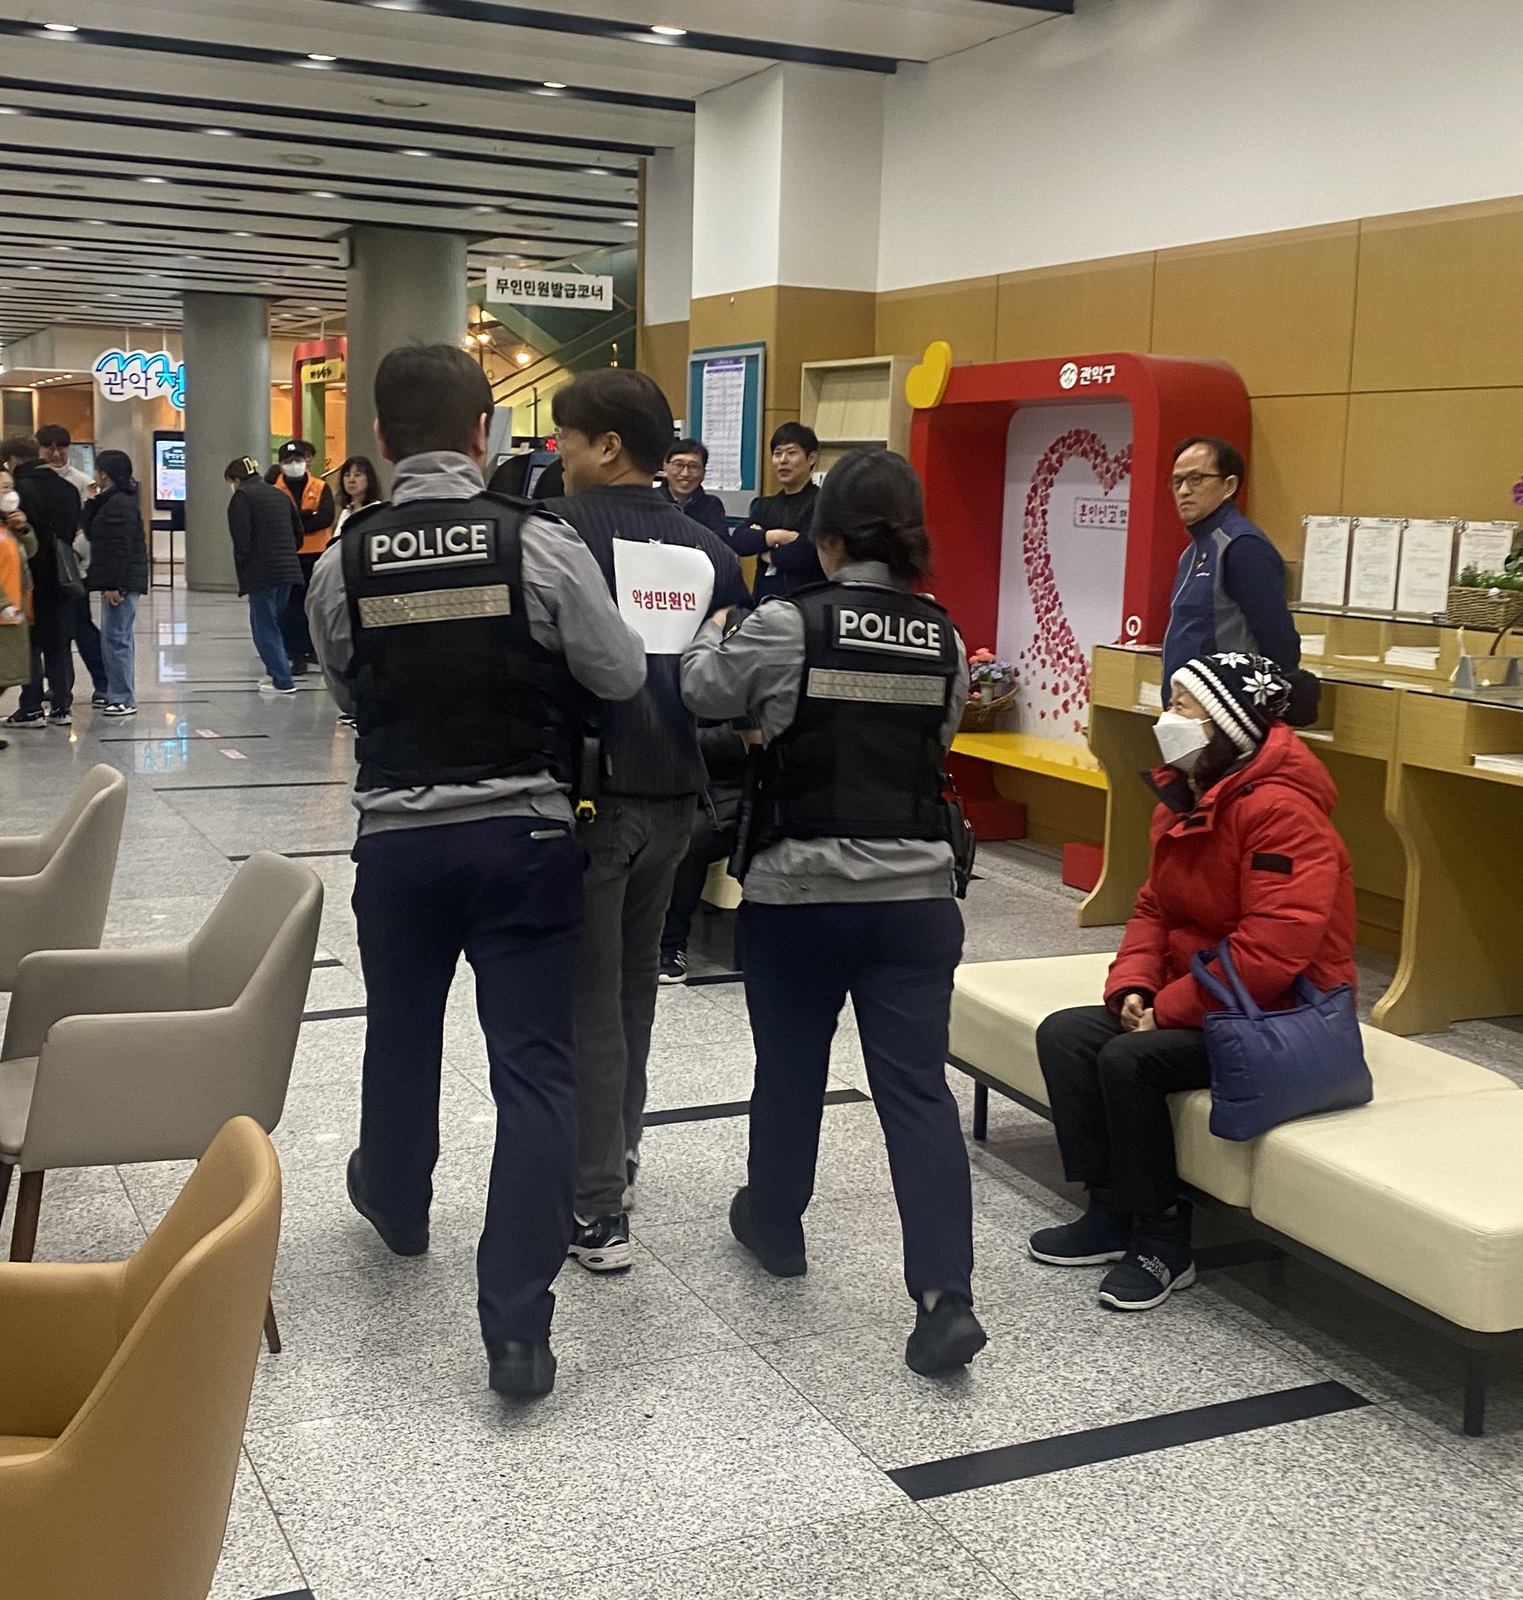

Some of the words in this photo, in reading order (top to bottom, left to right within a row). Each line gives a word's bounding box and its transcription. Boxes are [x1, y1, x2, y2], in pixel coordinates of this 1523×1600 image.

[496, 279, 603, 300] 무인민원발급코너
[1080, 365, 1116, 385] 관악구
[371, 525, 487, 562] POLICE
[632, 589, 696, 611] 악성민원인
[840, 610, 941, 648] POLICE
